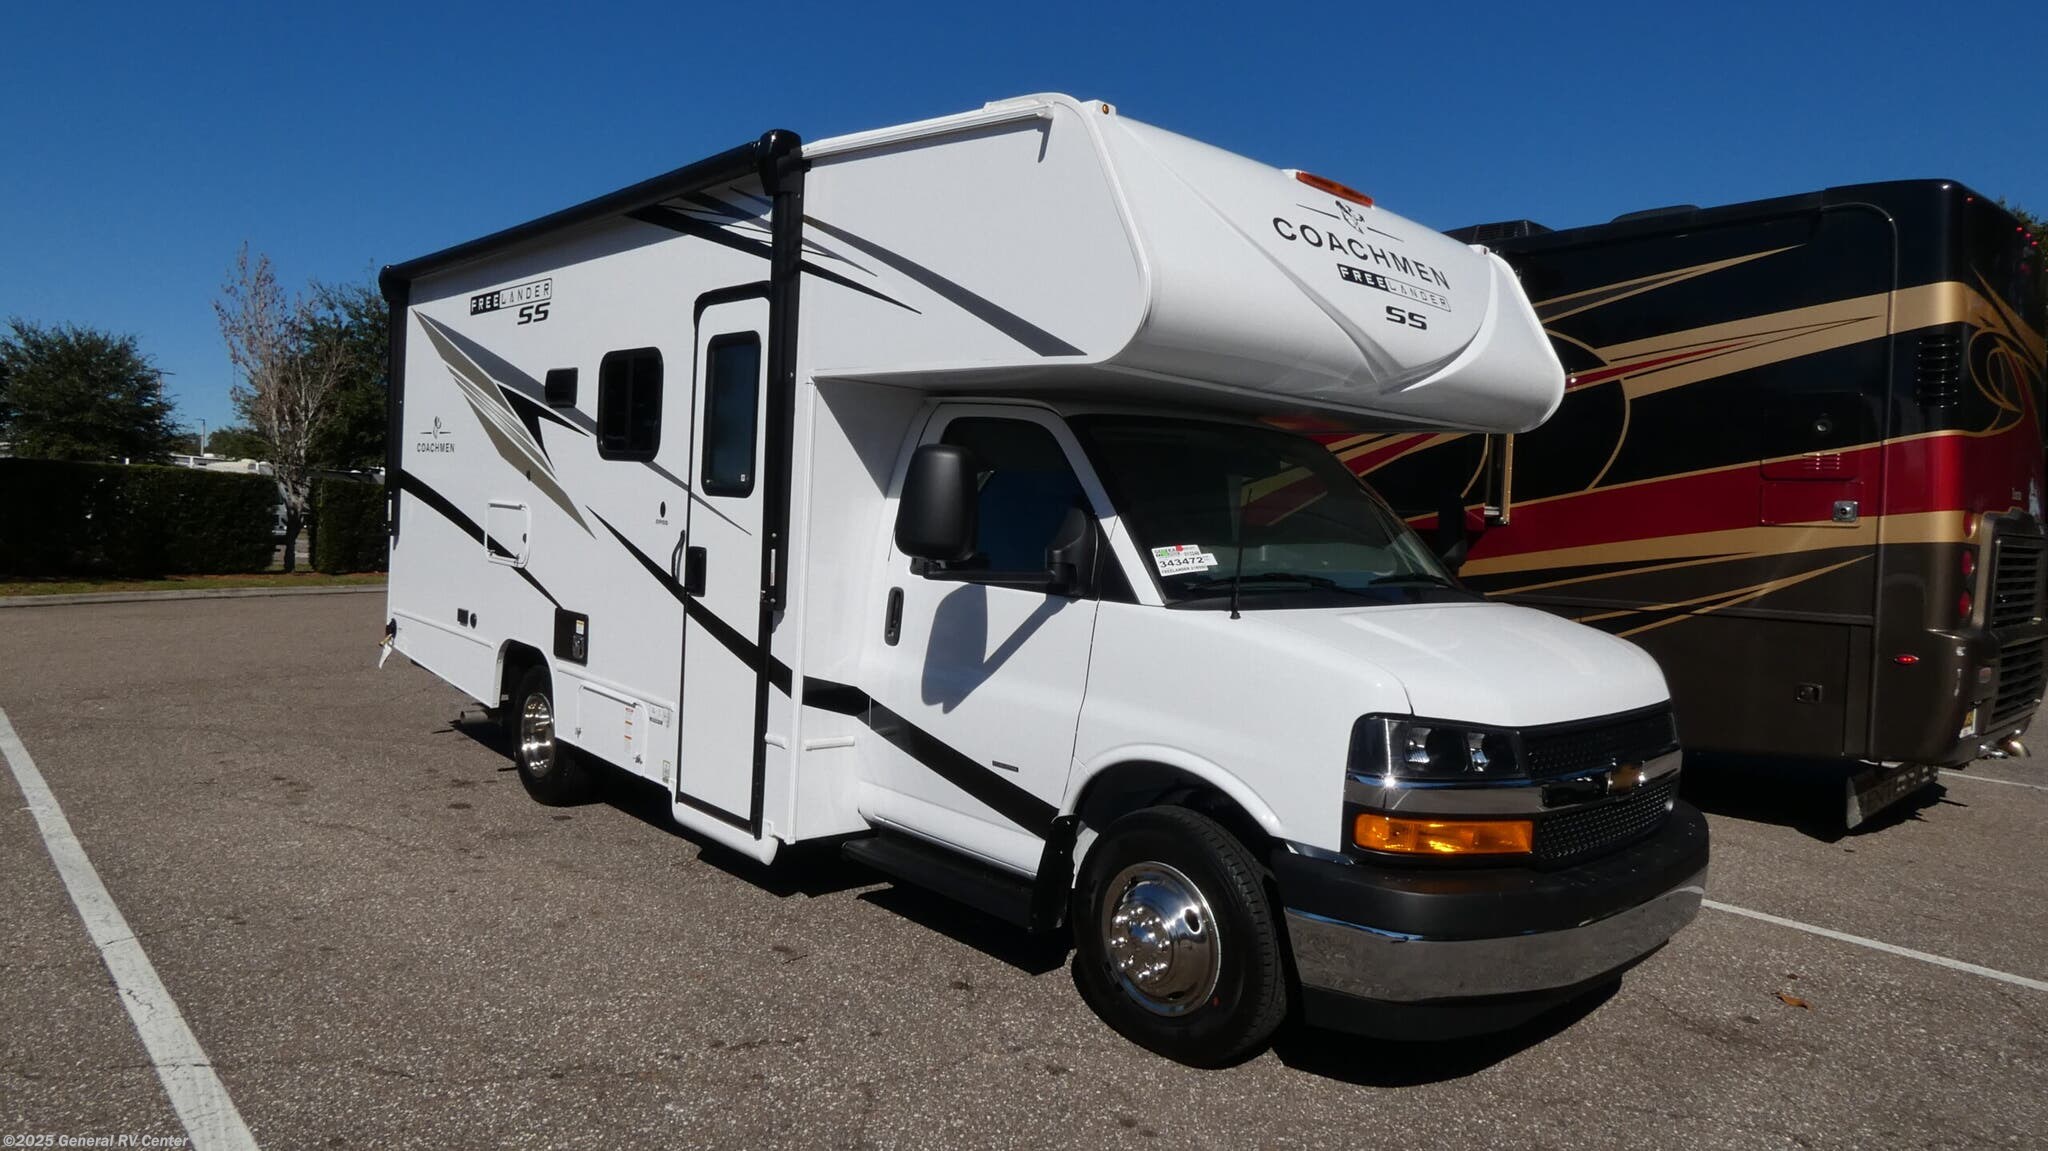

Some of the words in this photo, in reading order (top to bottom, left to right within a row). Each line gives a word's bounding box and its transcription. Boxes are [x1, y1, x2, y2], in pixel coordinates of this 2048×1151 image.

[1272, 217, 1450, 289] COACHMEN
[471, 281, 551, 314] FREELANDER
[1338, 265, 1450, 310] FREELANDER
[517, 302, 551, 326] SS
[1386, 305, 1427, 330] SS
[416, 442, 456, 454] COACHMEN
[1160, 557, 1204, 568] 343472
